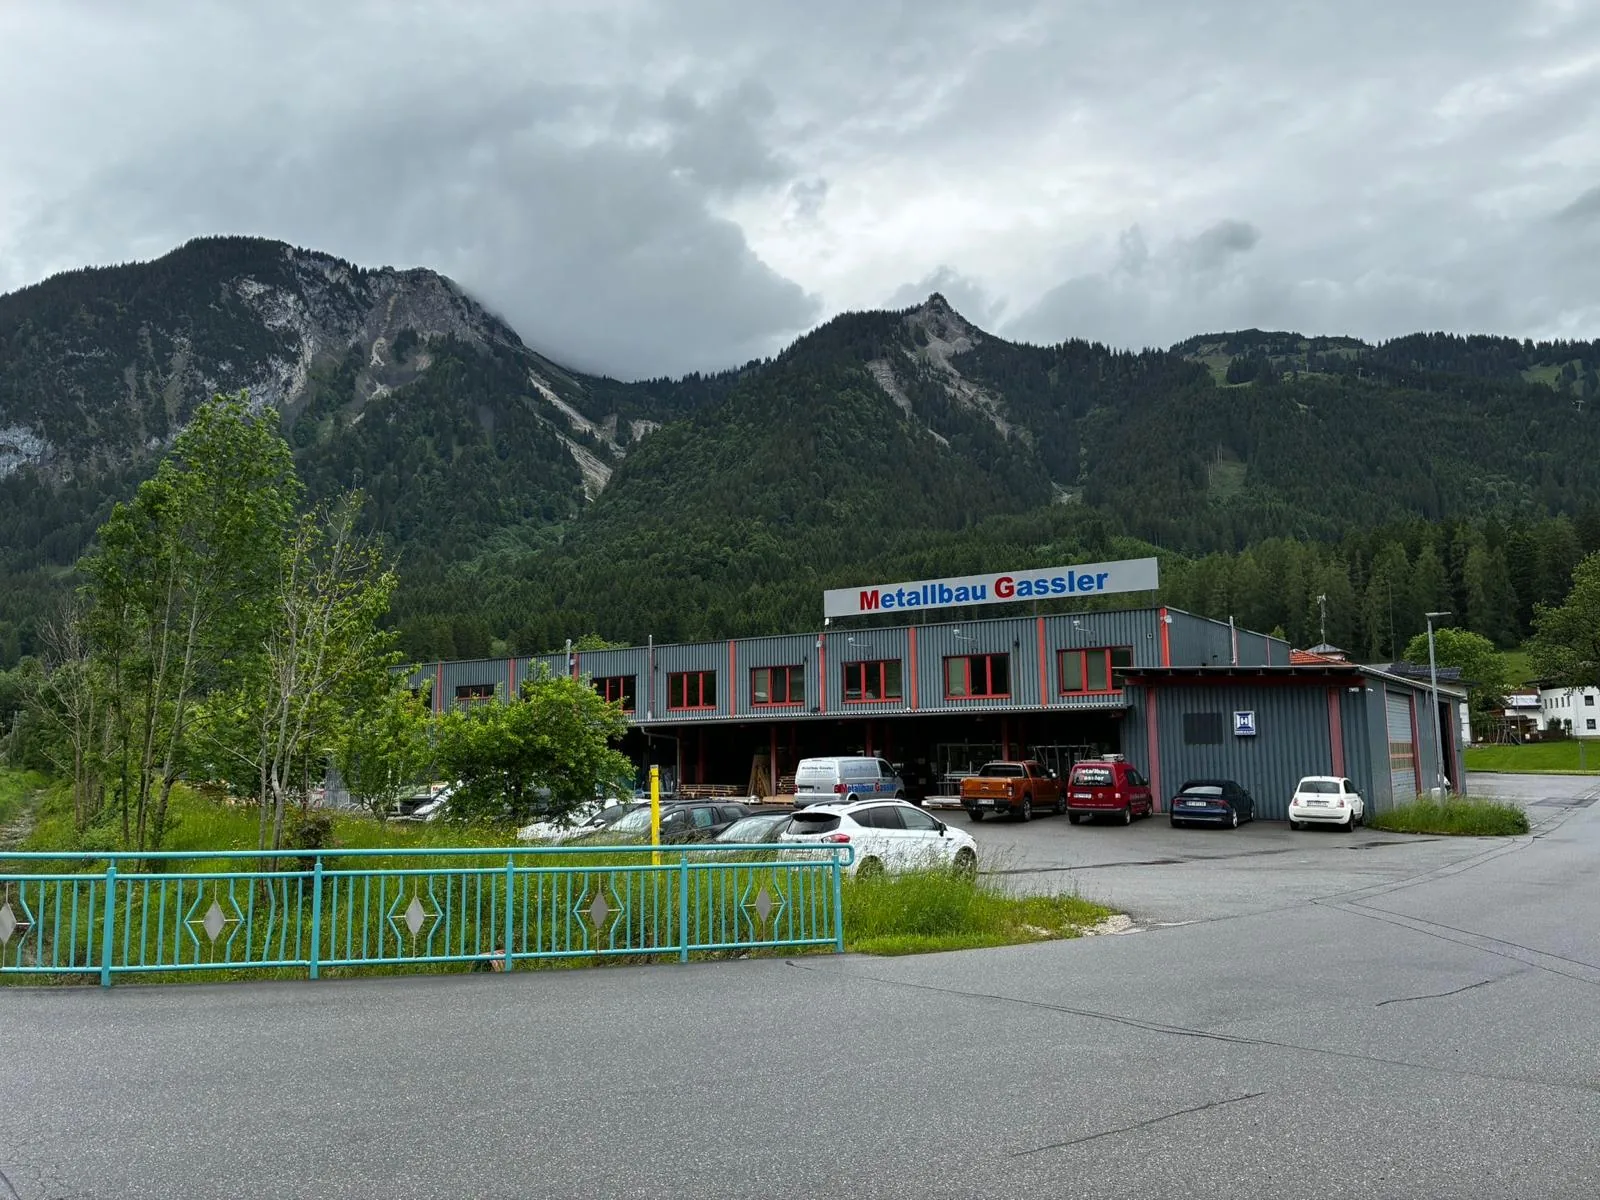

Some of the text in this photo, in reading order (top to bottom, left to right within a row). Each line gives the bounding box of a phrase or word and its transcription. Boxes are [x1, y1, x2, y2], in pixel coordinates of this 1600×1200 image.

[860, 570, 1109, 610] Metallbau Gassler
[1240, 717, 1248, 725] H
